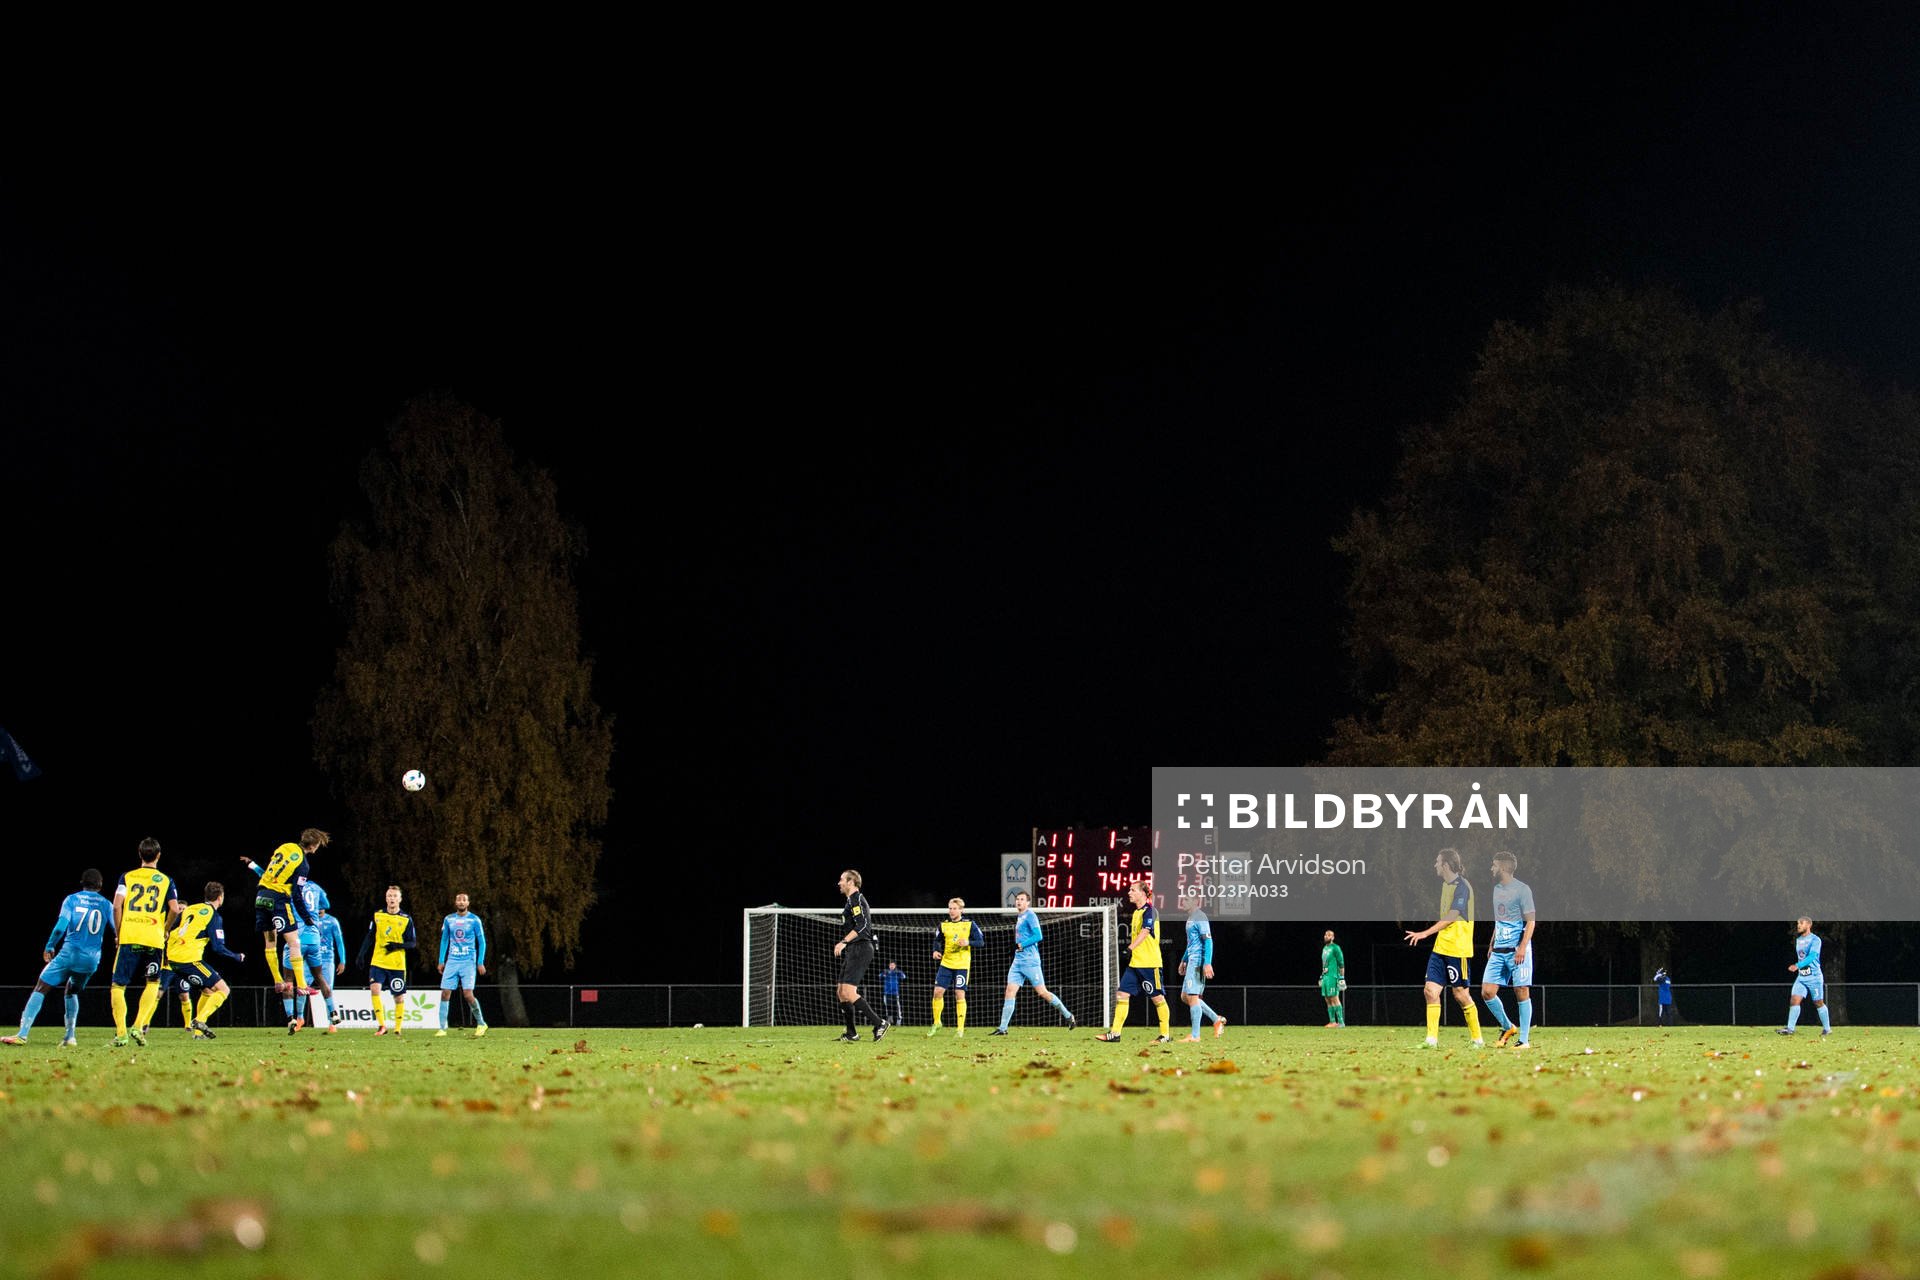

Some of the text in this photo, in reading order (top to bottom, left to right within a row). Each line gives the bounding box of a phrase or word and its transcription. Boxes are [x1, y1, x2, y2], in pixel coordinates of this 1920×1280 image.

[1038, 835, 1047, 846] A
[1037, 856, 1046, 866] B
[1098, 853, 1151, 868] H 2 G
[1037, 877, 1046, 888] C
[128, 883, 160, 913] 23
[1088, 897, 1124, 908] PUBLIK
[75, 906, 102, 935] 70
